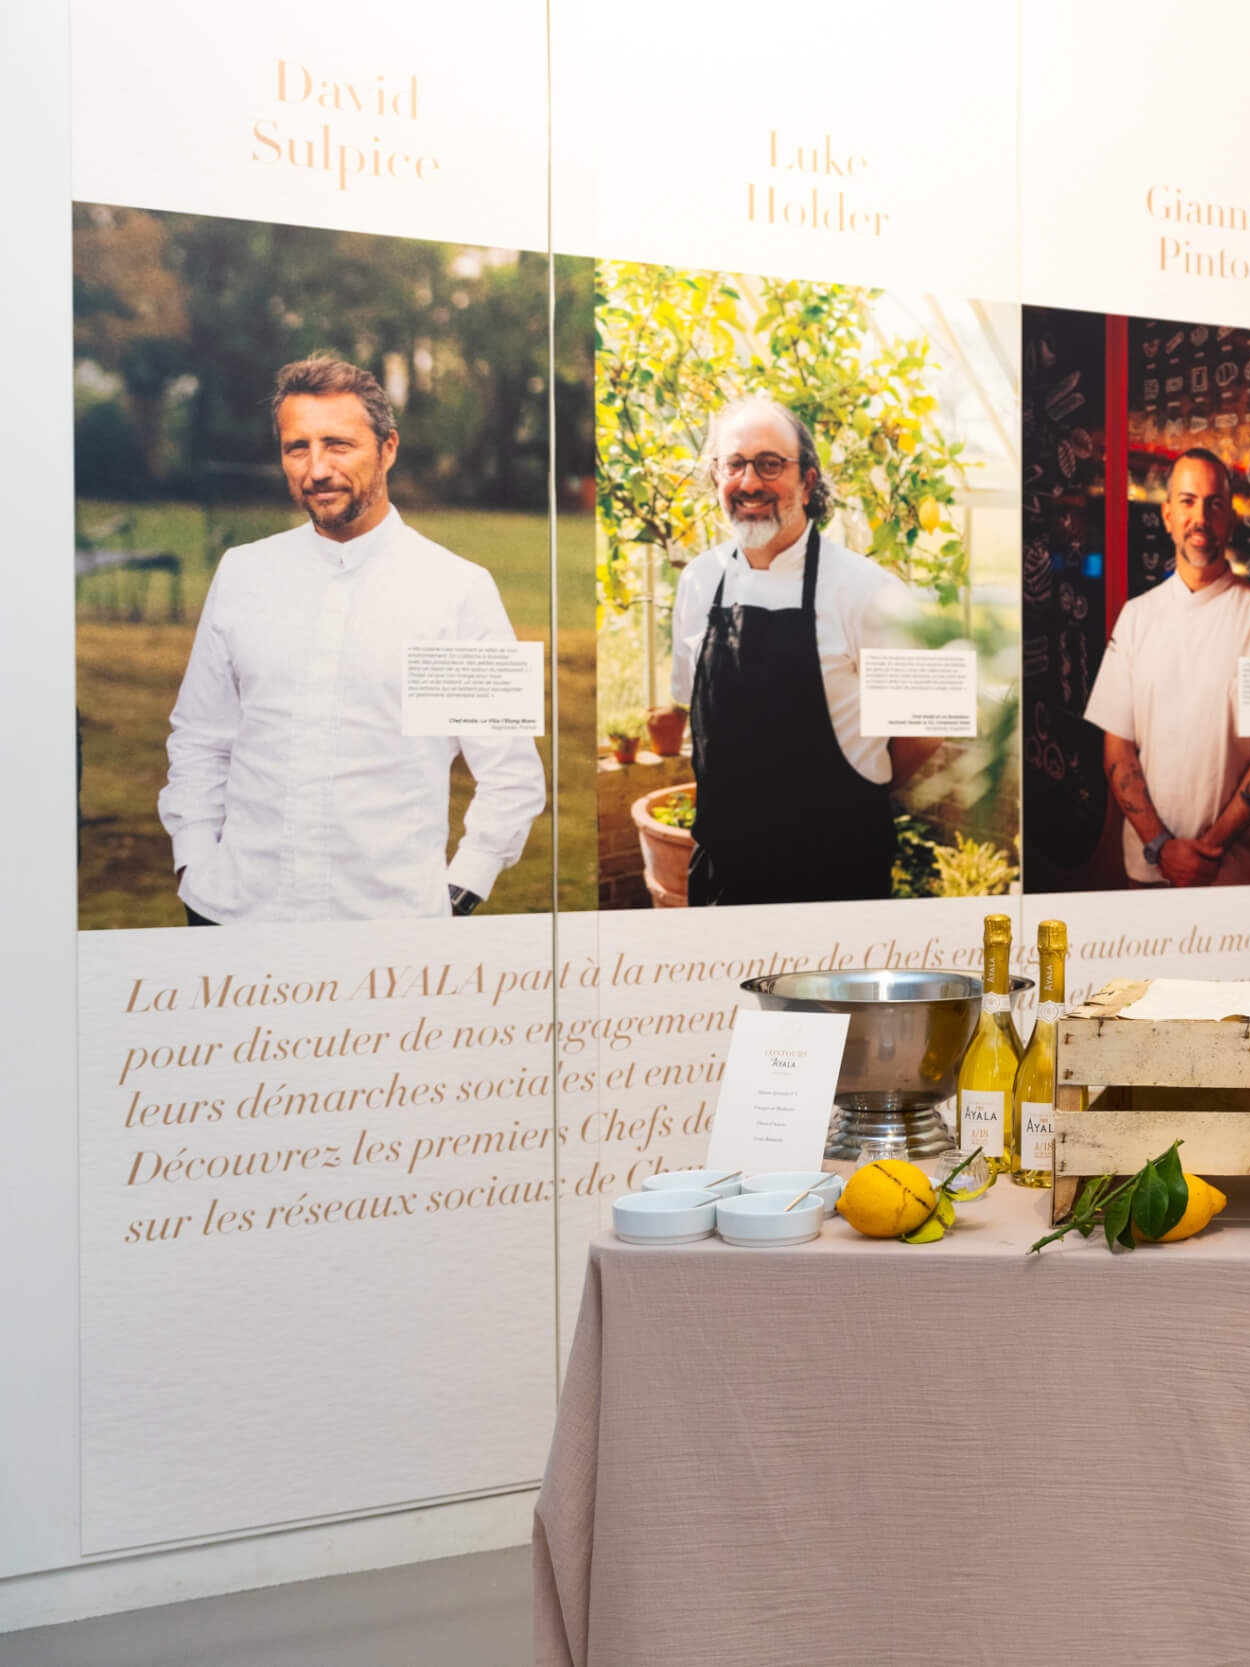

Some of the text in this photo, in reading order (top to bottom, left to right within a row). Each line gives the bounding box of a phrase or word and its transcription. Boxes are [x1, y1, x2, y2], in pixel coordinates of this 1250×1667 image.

[274, 59, 418, 120] David
[251, 119, 442, 192] Sulpice
[770, 130, 868, 177] Luke
[747, 182, 891, 237] Holder
[1160, 236, 1250, 280] Pinto
[121, 978, 179, 1013] La
[191, 973, 339, 1010] Maison
[348, 962, 486, 1000] AYALA
[492, 961, 571, 1007] part
[579, 955, 601, 988] à
[610, 952, 645, 987] la
[653, 950, 809, 985] rencontre
[817, 941, 853, 971] de
[863, 935, 945, 969] Chefs
[1080, 934, 1173, 961] autour
[1178, 924, 1212, 953] du
[118, 1042, 224, 1086] pour
[232, 1025, 391, 1065] discuter
[400, 1015, 443, 1052] de
[452, 1022, 517, 1050] nos
[125, 1090, 226, 1129] leurs
[236, 1071, 447, 1121] démarches
[455, 1060, 597, 1103] sociales
[606, 1062, 636, 1091] et
[965, 1106, 998, 1121] AYALA
[1026, 1117, 1056, 1134] AYAL
[123, 1146, 342, 1187] Découvrez
[352, 1129, 404, 1166] les
[407, 1120, 569, 1175] premiers
[580, 1104, 674, 1153] Chefs
[124, 1215, 193, 1244] sur
[202, 1198, 257, 1237] les
[265, 1192, 418, 1230] réseaux
[574, 1161, 617, 1197] de
